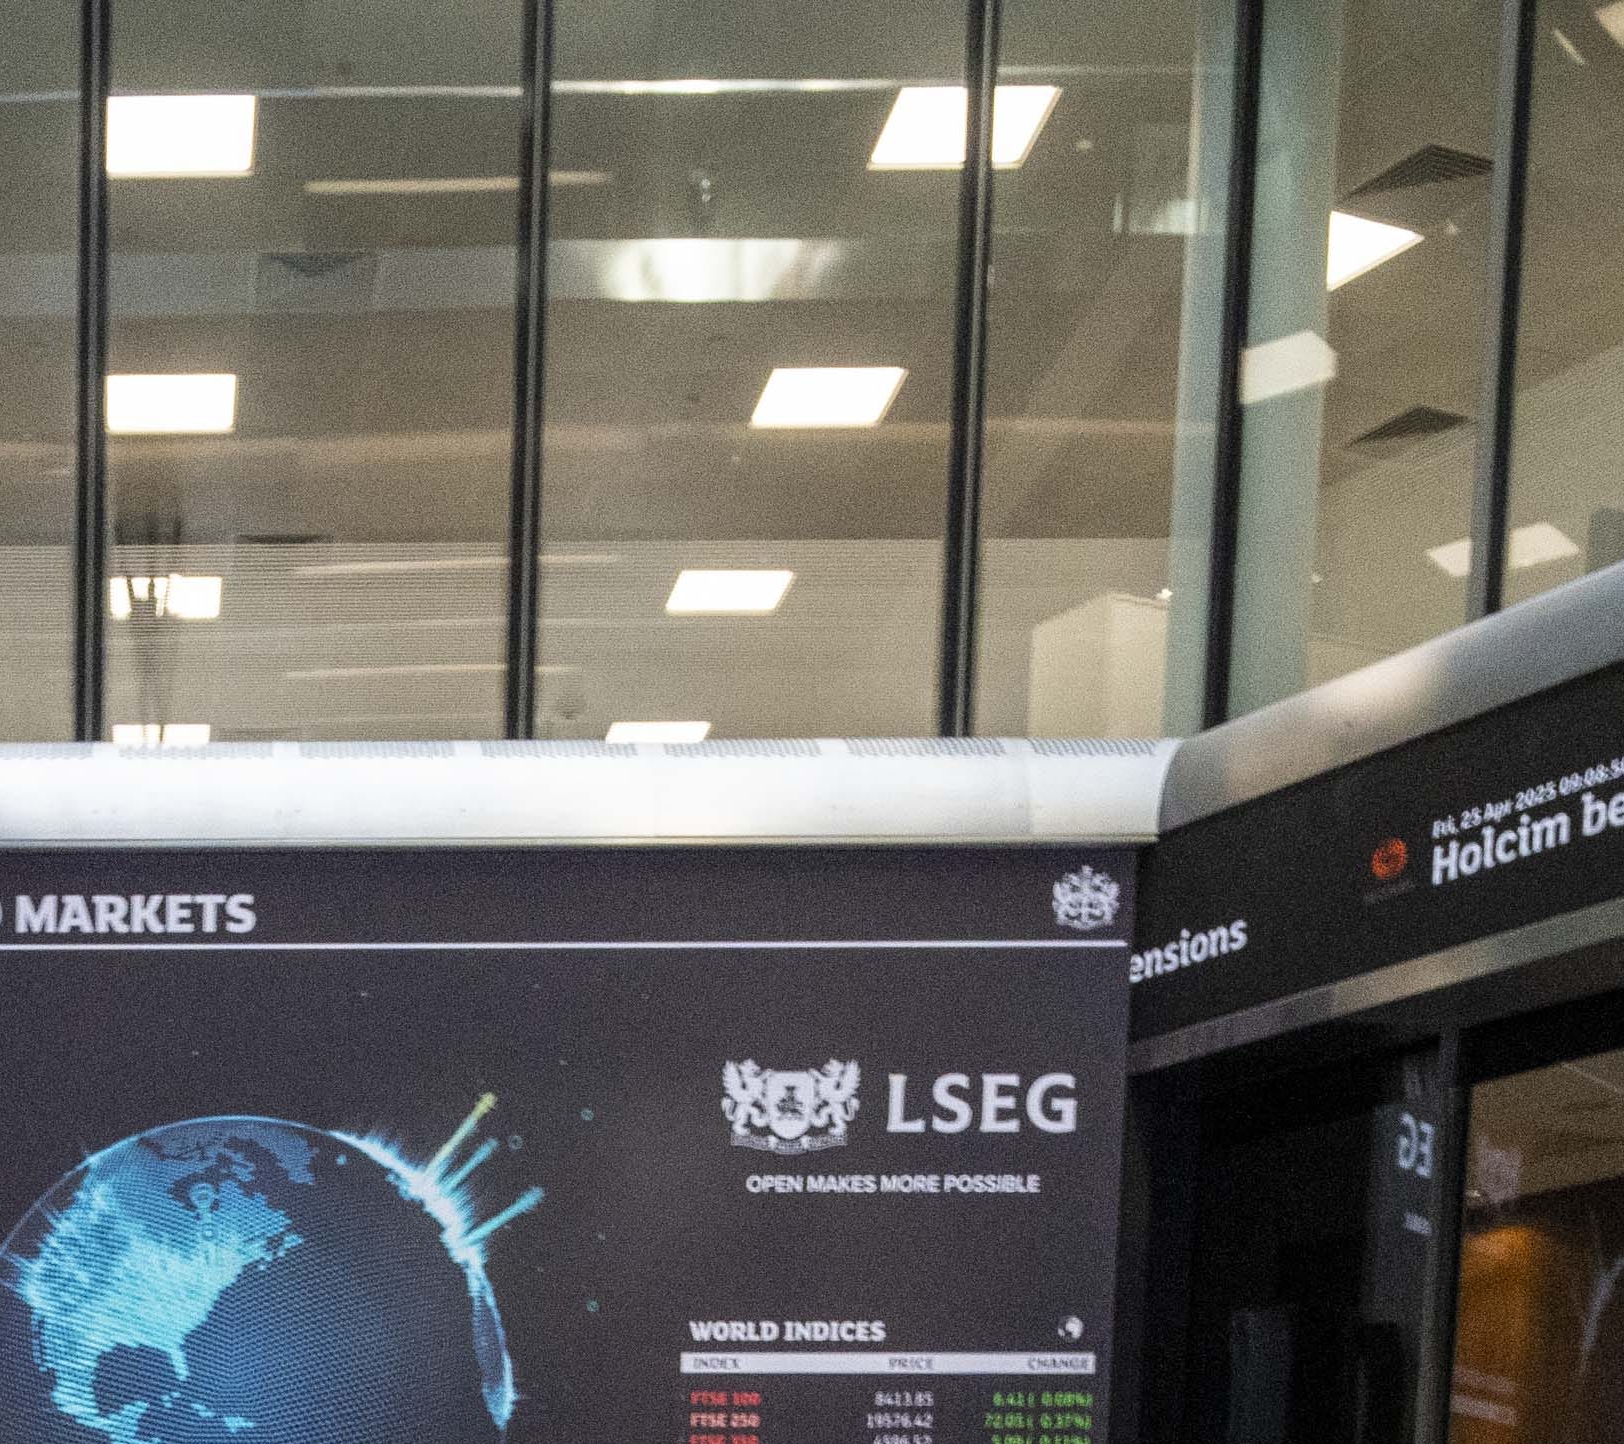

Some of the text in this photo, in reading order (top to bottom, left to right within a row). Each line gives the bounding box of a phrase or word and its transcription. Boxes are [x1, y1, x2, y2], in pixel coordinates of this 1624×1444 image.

[1483, 799, 1513, 824] Apr
[1431, 808, 1570, 887] Holcim
[16, 894, 256, 933] MARKETS
[887, 1073, 1077, 1133] LSEG
[746, 1175, 1040, 1193] OPEN MAKES MORE POSSIBLE
[689, 1321, 886, 1341] WORLD INDICES
